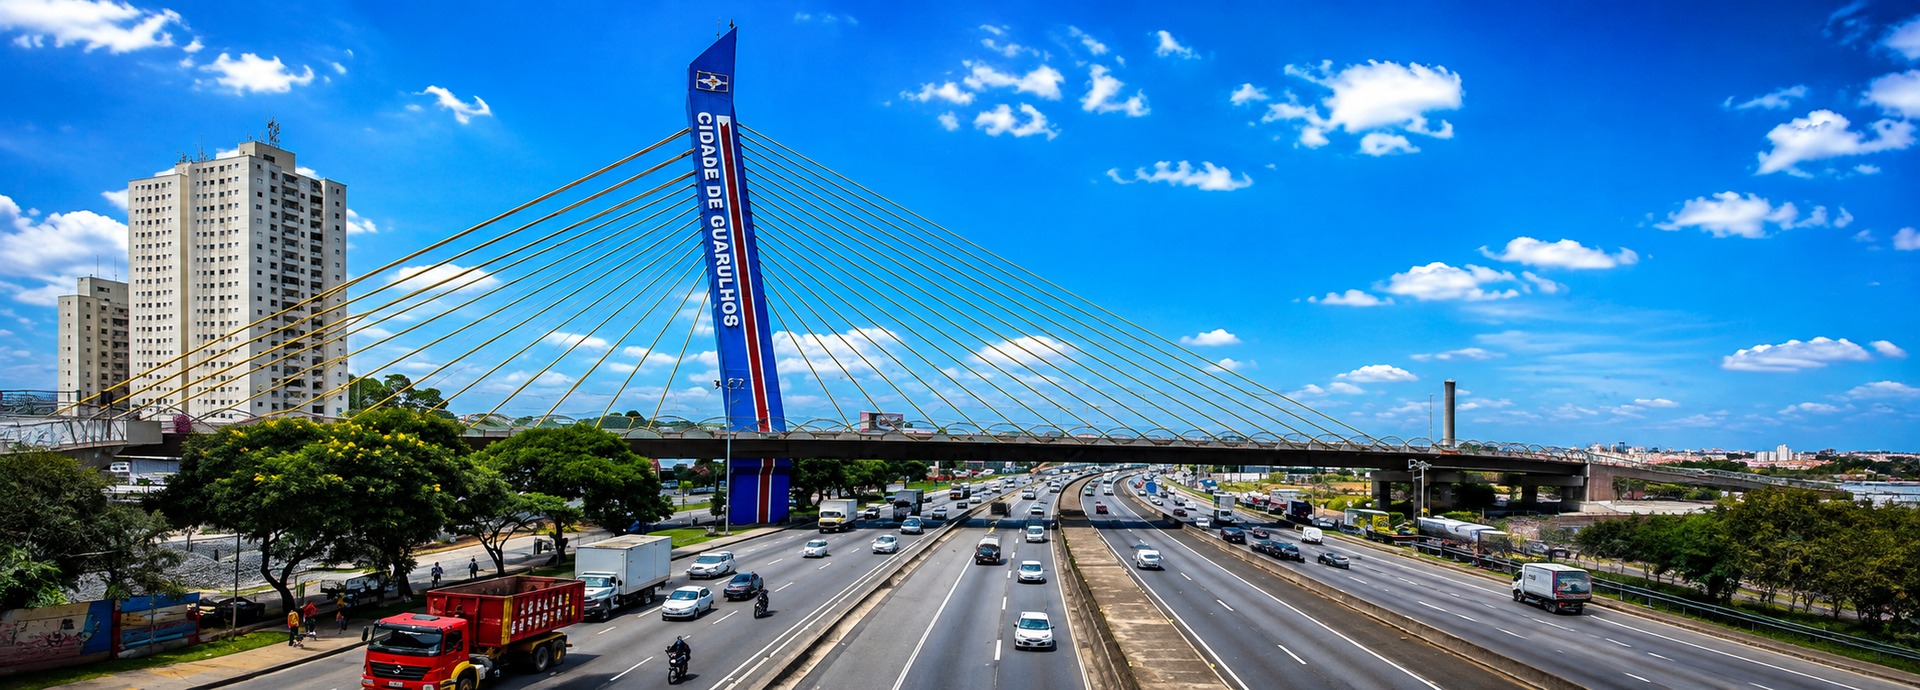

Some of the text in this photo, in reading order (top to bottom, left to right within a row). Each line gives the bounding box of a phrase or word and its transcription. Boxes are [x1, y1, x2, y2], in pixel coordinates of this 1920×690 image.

[697, 111, 739, 327] CIDADE DE GUARULHOS
